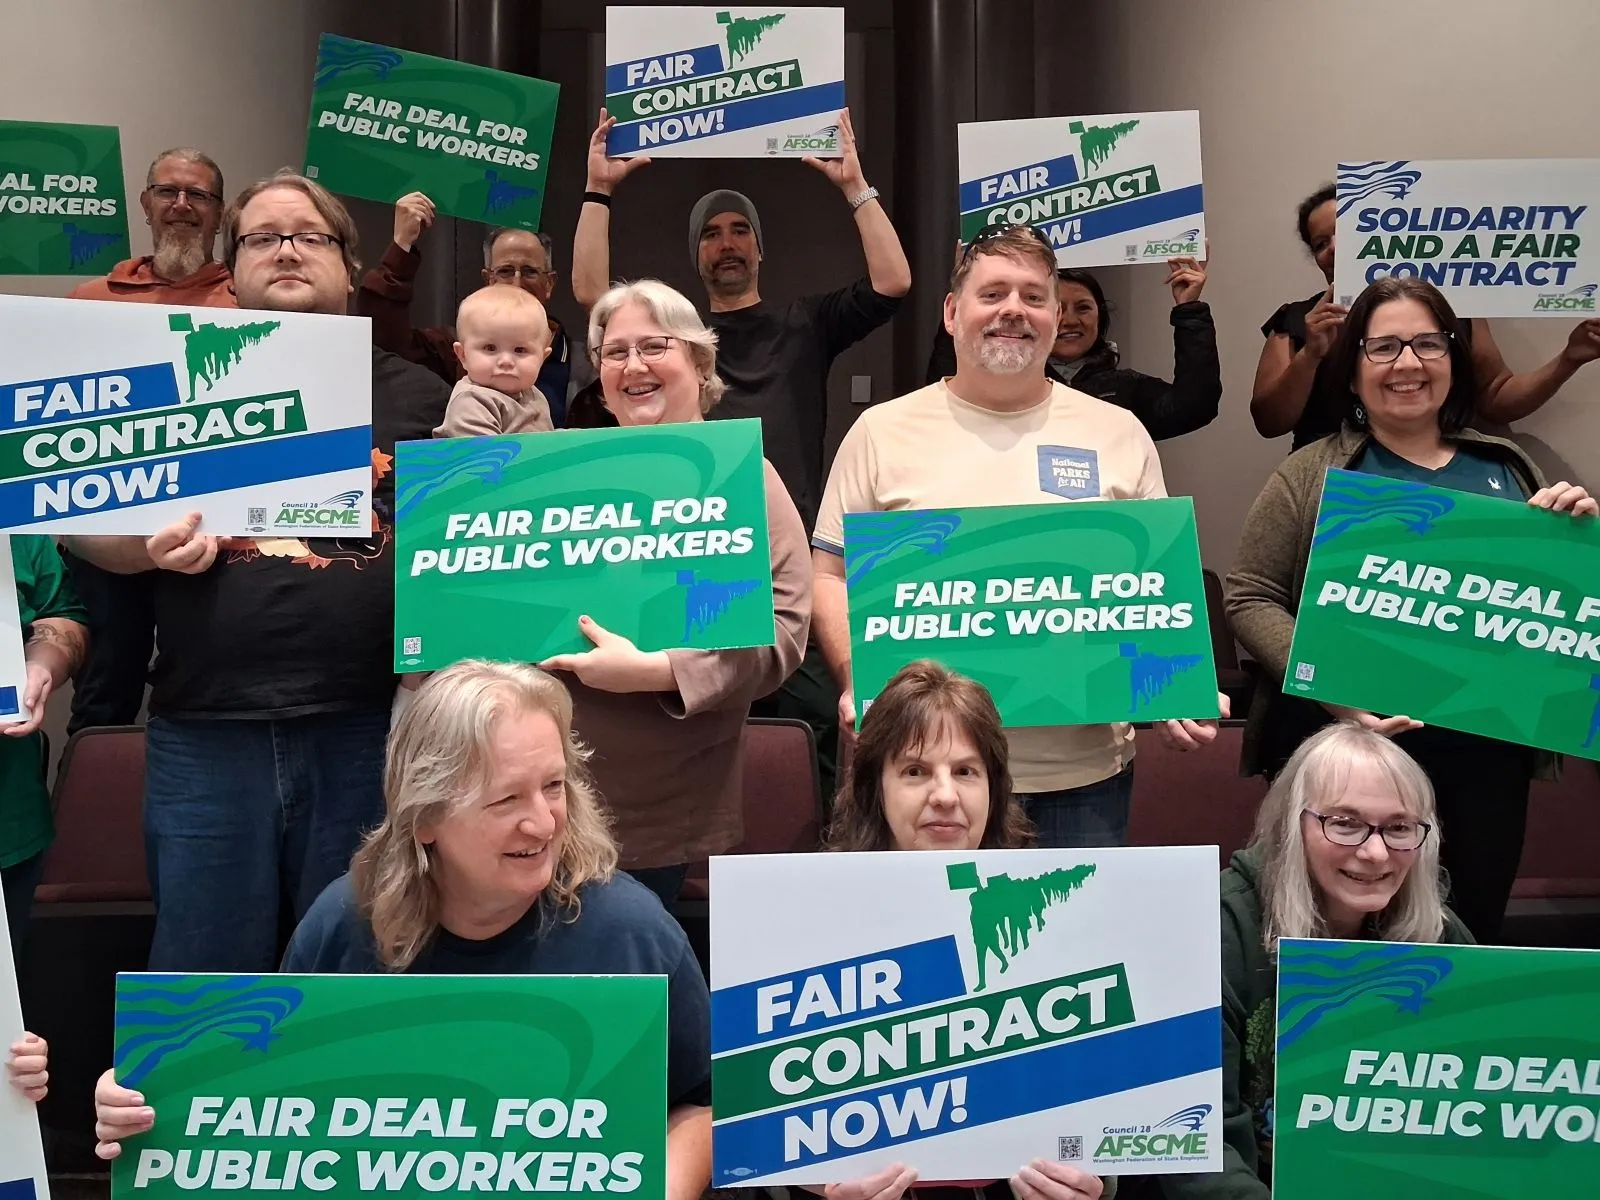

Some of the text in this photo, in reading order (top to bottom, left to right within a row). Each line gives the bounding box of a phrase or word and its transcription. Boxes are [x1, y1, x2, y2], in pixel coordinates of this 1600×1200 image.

[626, 53, 695, 87] FAIR
[632, 63, 796, 116] CONTRACT
[343, 92, 528, 146] FAIR DEAL FOR
[638, 108, 725, 147] NOW!
[317, 110, 541, 171] PUBLIC WORKERS
[783, 138, 838, 149] AFSCME
[42, 174, 98, 194] FOR
[980, 165, 1049, 203] FAIR
[986, 169, 1152, 227] CONTRACT
[1041, 218, 1082, 247] W!
[1355, 204, 1588, 233] SOLIDARITY
[1143, 242, 1199, 255] AFSCME
[1356, 233, 1581, 260] AND A FAIR
[1365, 261, 1577, 287] CONTRACT
[1533, 297, 1595, 309] AFSCME
[14, 375, 131, 422] FAIR
[22, 396, 295, 468] CONTRACT
[1052, 457, 1089, 468] National
[1053, 468, 1090, 479] PARKS
[33, 461, 180, 518] NOW!
[274, 508, 361, 525] AFSCME
[445, 496, 728, 541] FAIR DEAL FOR
[410, 527, 754, 577] PUBLIC WORKERS
[894, 571, 1165, 608] FAIR DEAL FOR
[1316, 581, 1464, 632] PUBLIC
[1358, 554, 1452, 595] FAIR
[1457, 573, 1566, 619] DEAL
[864, 602, 1193, 643] PUBLIC WORKERS
[756, 959, 902, 1035] FAIR
[768, 974, 1119, 1096] CONTRACT
[1343, 1049, 1600, 1096] FAIR DEAL
[184, 1097, 608, 1139] FAIR DEAL FOR
[784, 1076, 968, 1163] NOW!
[1102, 1125, 1151, 1134] Council 28
[1295, 1093, 1600, 1145] PUBLIC WO
[1093, 1132, 1208, 1157] AFSCME
[133, 1149, 644, 1193] PUBLIC WORKERS
